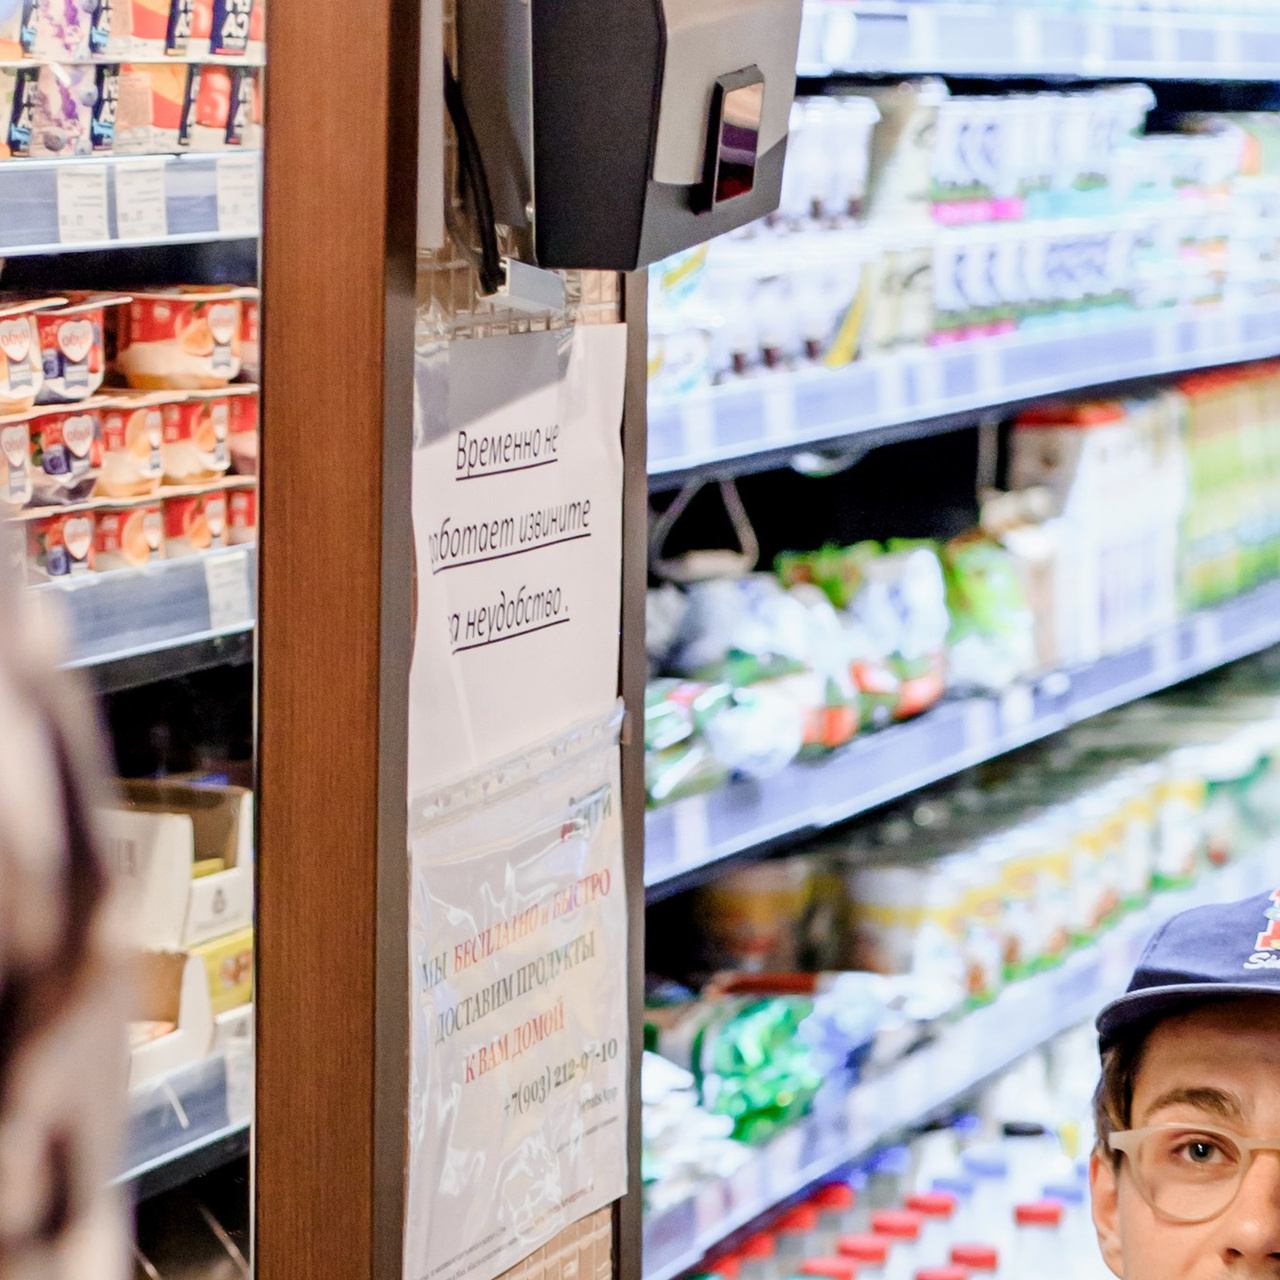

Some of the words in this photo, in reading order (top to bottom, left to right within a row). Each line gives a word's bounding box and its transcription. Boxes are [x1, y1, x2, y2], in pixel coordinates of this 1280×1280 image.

[456, 428, 541, 477] Временно
[543, 423, 559, 455] не
[519, 499, 590, 543] извините
[465, 585, 568, 642] неудобство.
[422, 951, 448, 993] МЫ
[552, 868, 611, 920] БЫСТРО
[434, 973, 514, 1047] ДОСТАВИМ
[516, 930, 596, 998] ПРОДУКТЫ
[464, 1053, 476, 1084] К
[478, 1033, 510, 1077] ВАМ
[511, 995, 565, 1061] ДОМОЙ
[553, 1038, 618, 1089] 212-9-10
